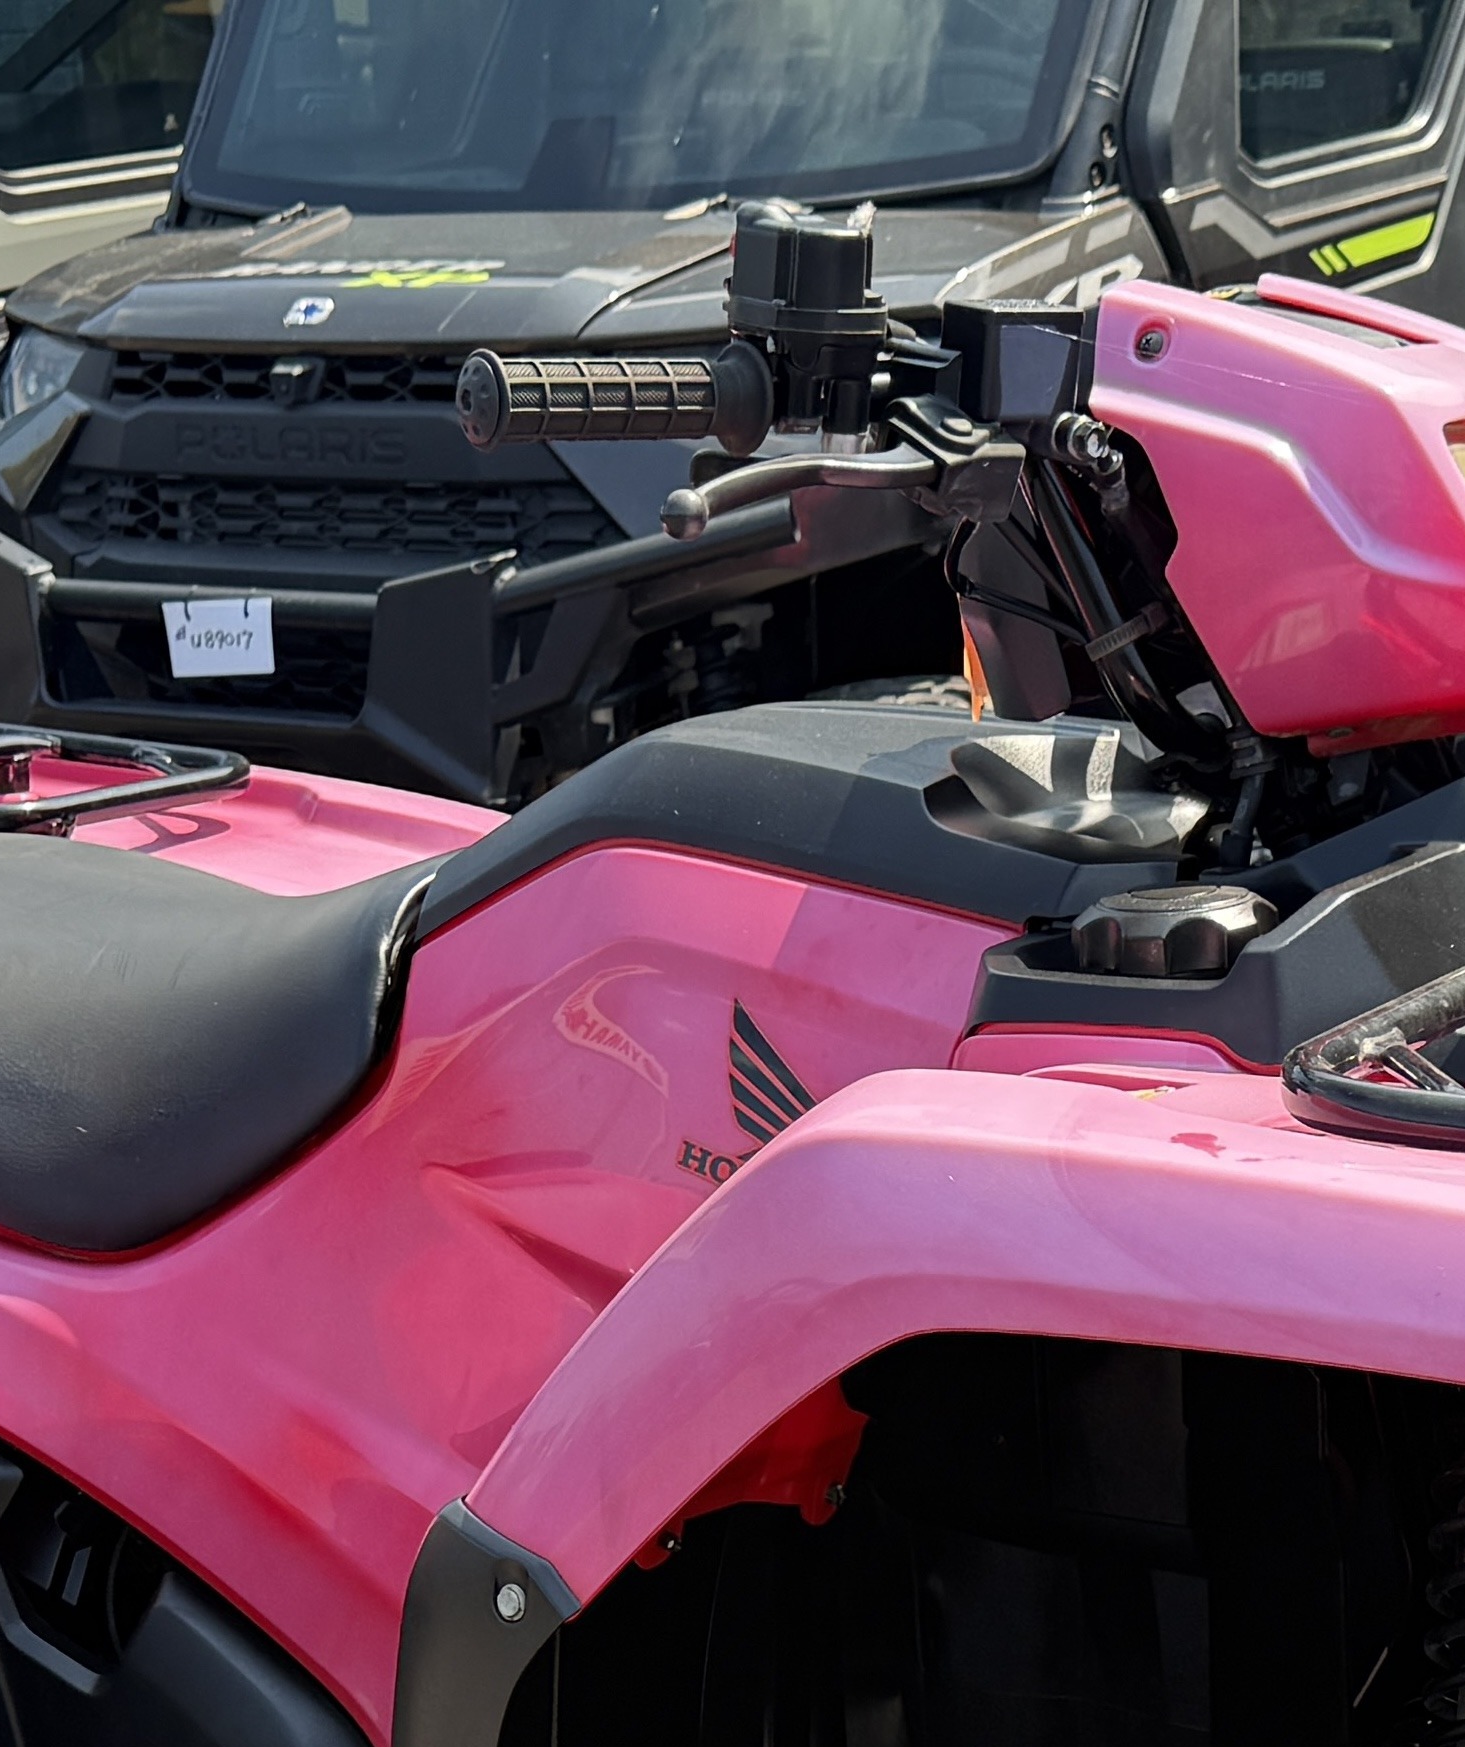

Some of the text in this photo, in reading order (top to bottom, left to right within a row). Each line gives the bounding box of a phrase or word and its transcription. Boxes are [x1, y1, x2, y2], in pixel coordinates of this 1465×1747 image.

[1240, 68, 1326, 92] LARIS
[175, 423, 408, 465] POLARIS
[678, 1140, 742, 1185] HO
